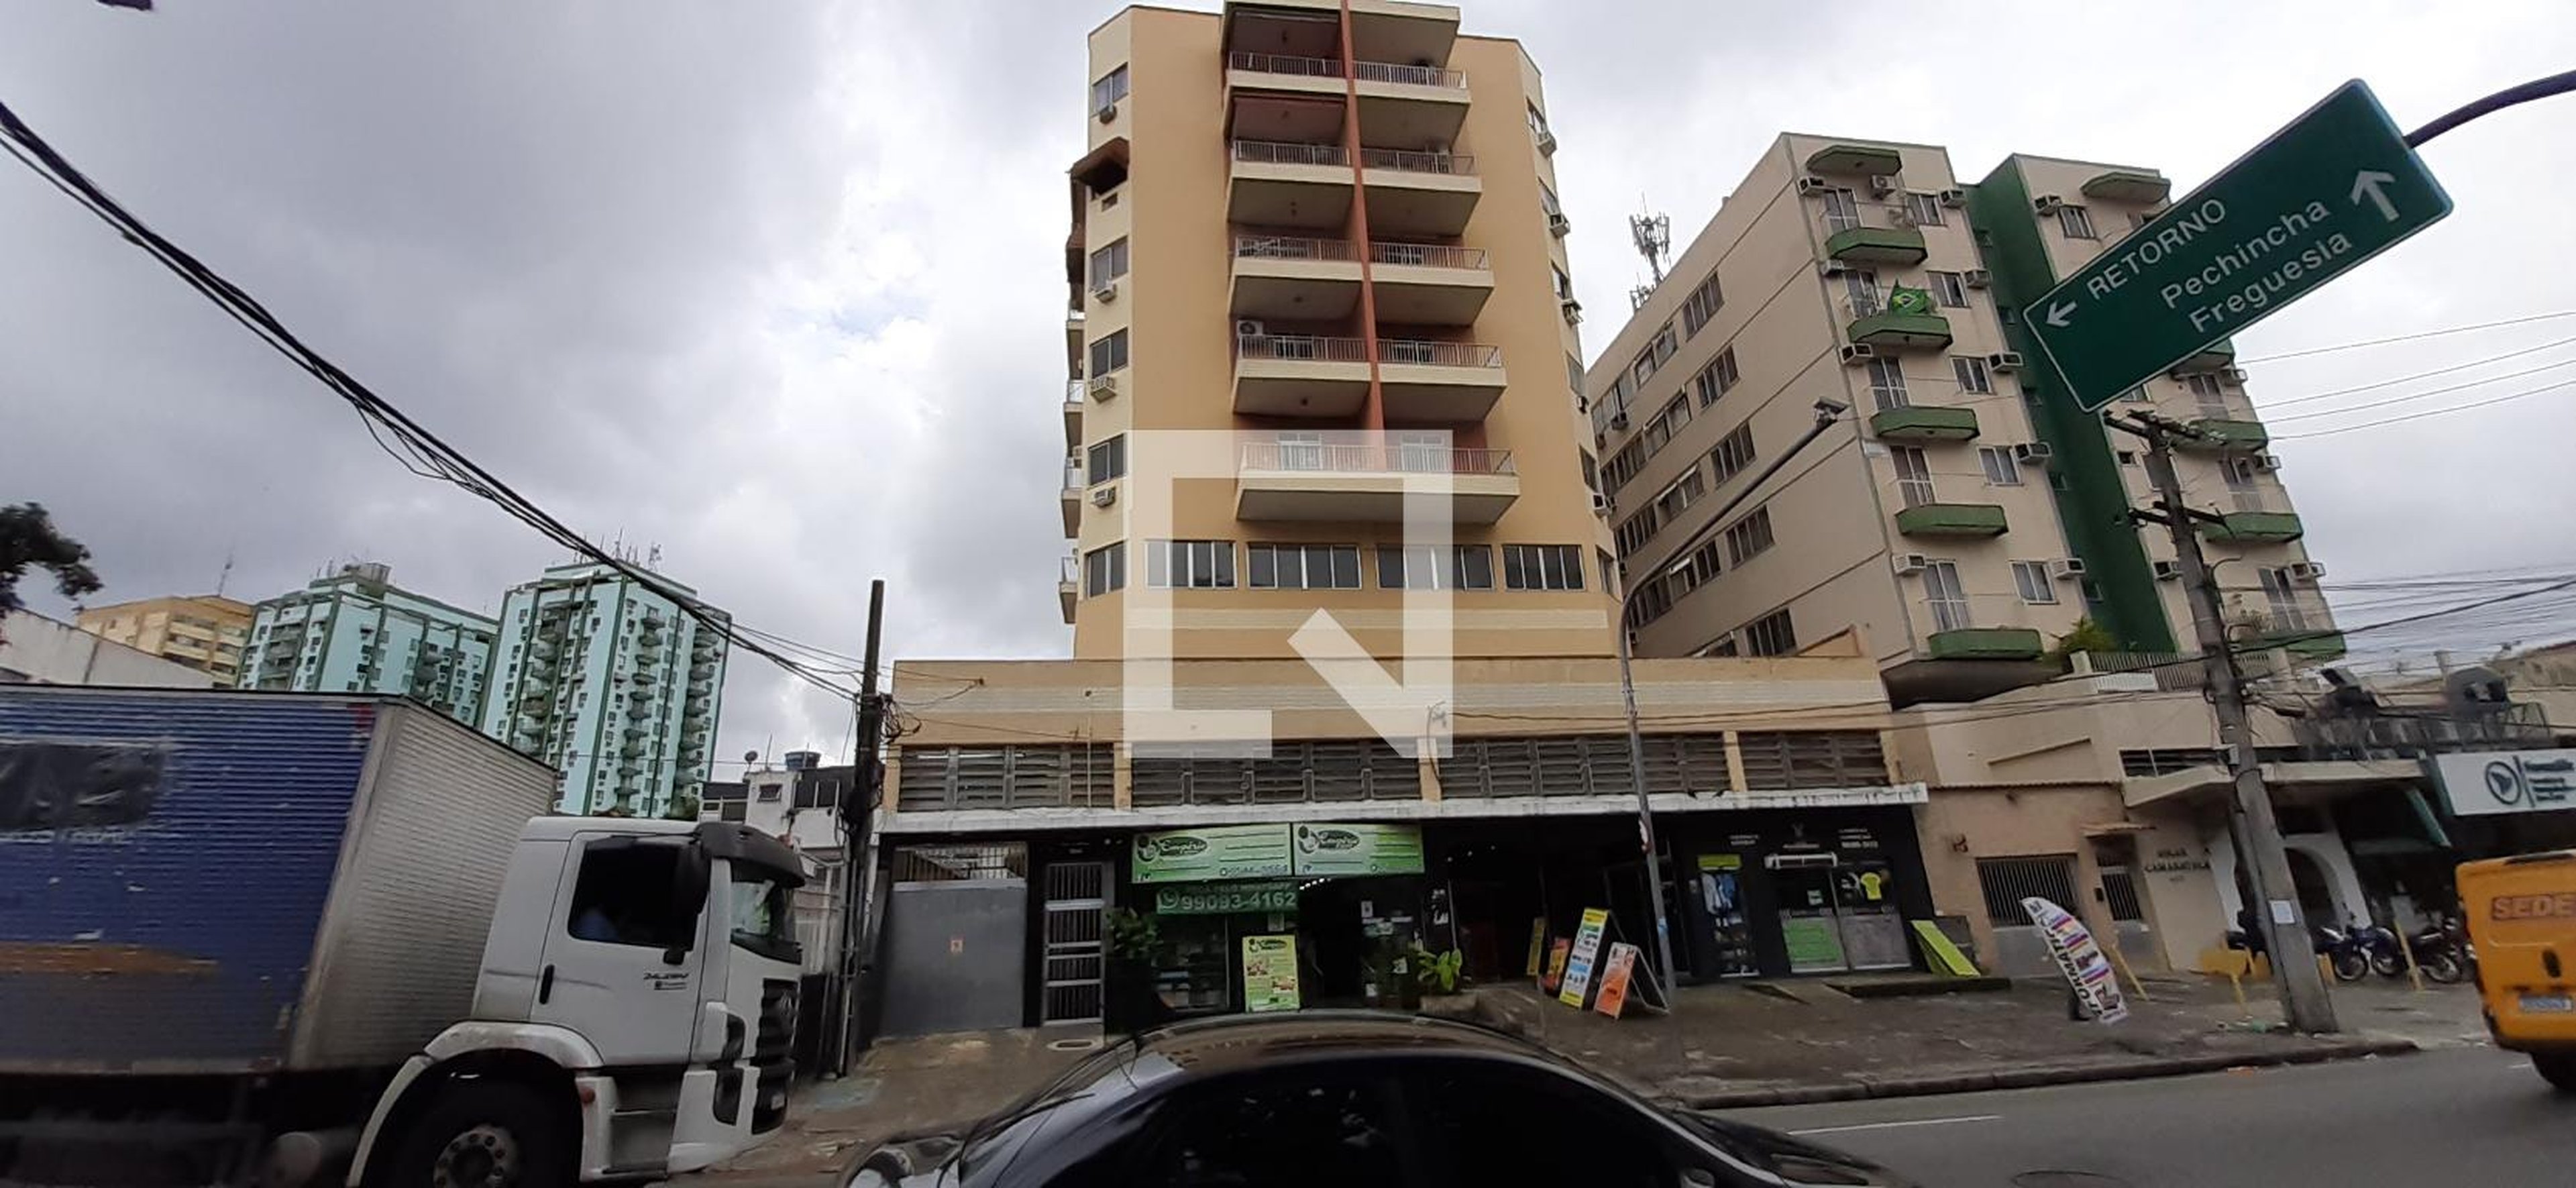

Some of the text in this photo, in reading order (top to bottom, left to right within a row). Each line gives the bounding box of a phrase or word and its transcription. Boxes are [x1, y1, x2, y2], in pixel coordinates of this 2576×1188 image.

[2086, 199, 2226, 300] RETORNO
[2160, 201, 2331, 309] Pechincha
[2188, 231, 2353, 333] Freguesia
